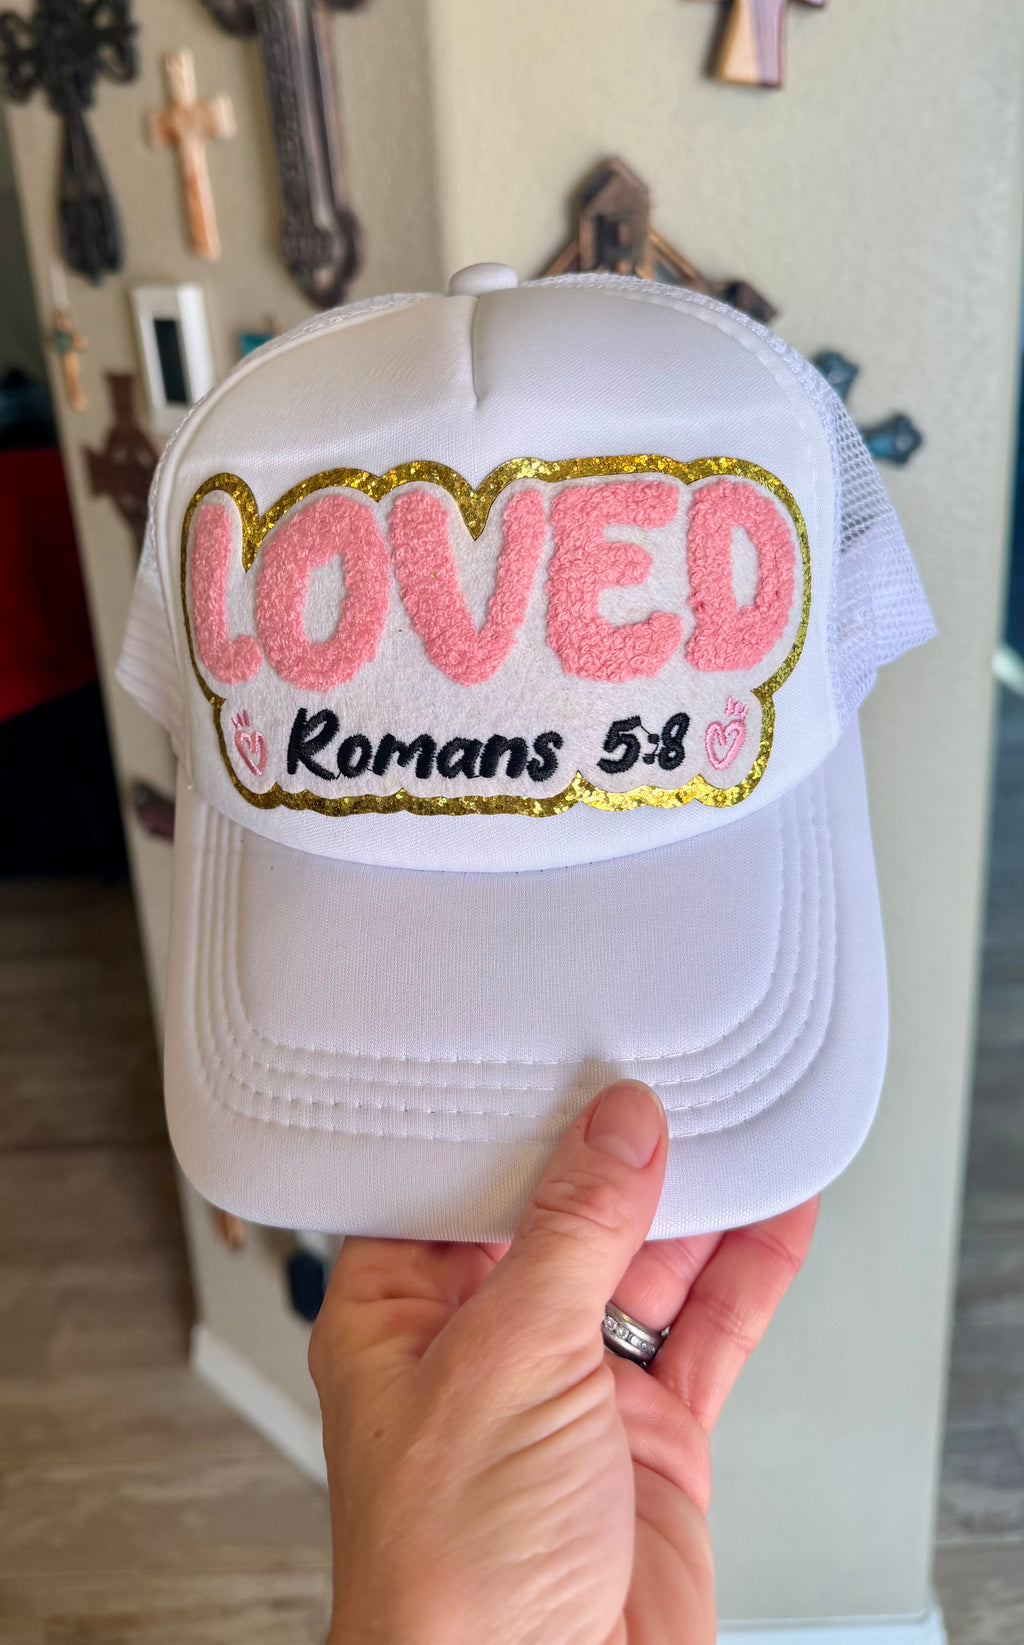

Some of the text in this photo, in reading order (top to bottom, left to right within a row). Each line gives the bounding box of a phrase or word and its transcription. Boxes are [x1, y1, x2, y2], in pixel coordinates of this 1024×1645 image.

[191, 479, 796, 692] LOVED
[286, 707, 691, 782] Romans 5:8
